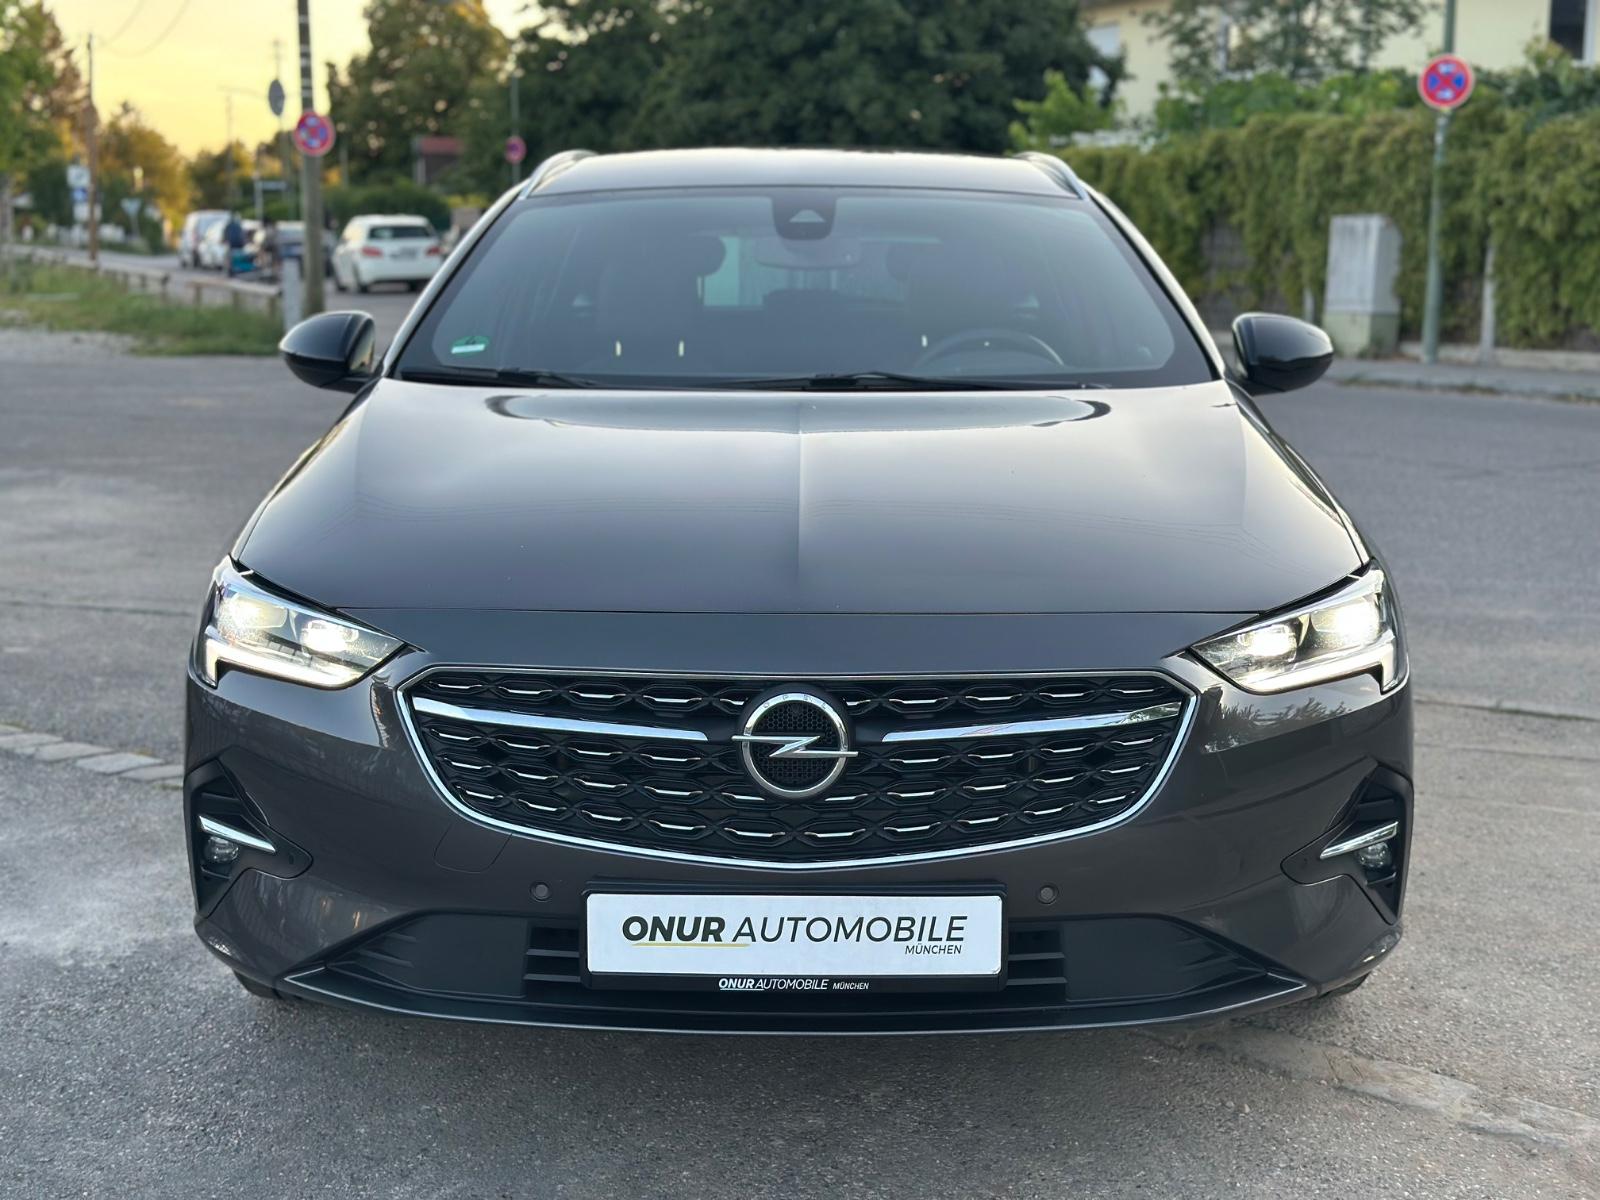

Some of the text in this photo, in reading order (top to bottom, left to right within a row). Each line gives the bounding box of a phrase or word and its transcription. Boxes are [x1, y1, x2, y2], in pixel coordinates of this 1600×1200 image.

[622, 915, 968, 942] ONUR AUTOMOBILE
[904, 943, 962, 955] MÜNCHEN
[718, 977, 869, 990] ONUR AUTOMOBILE MÜNCHEN
